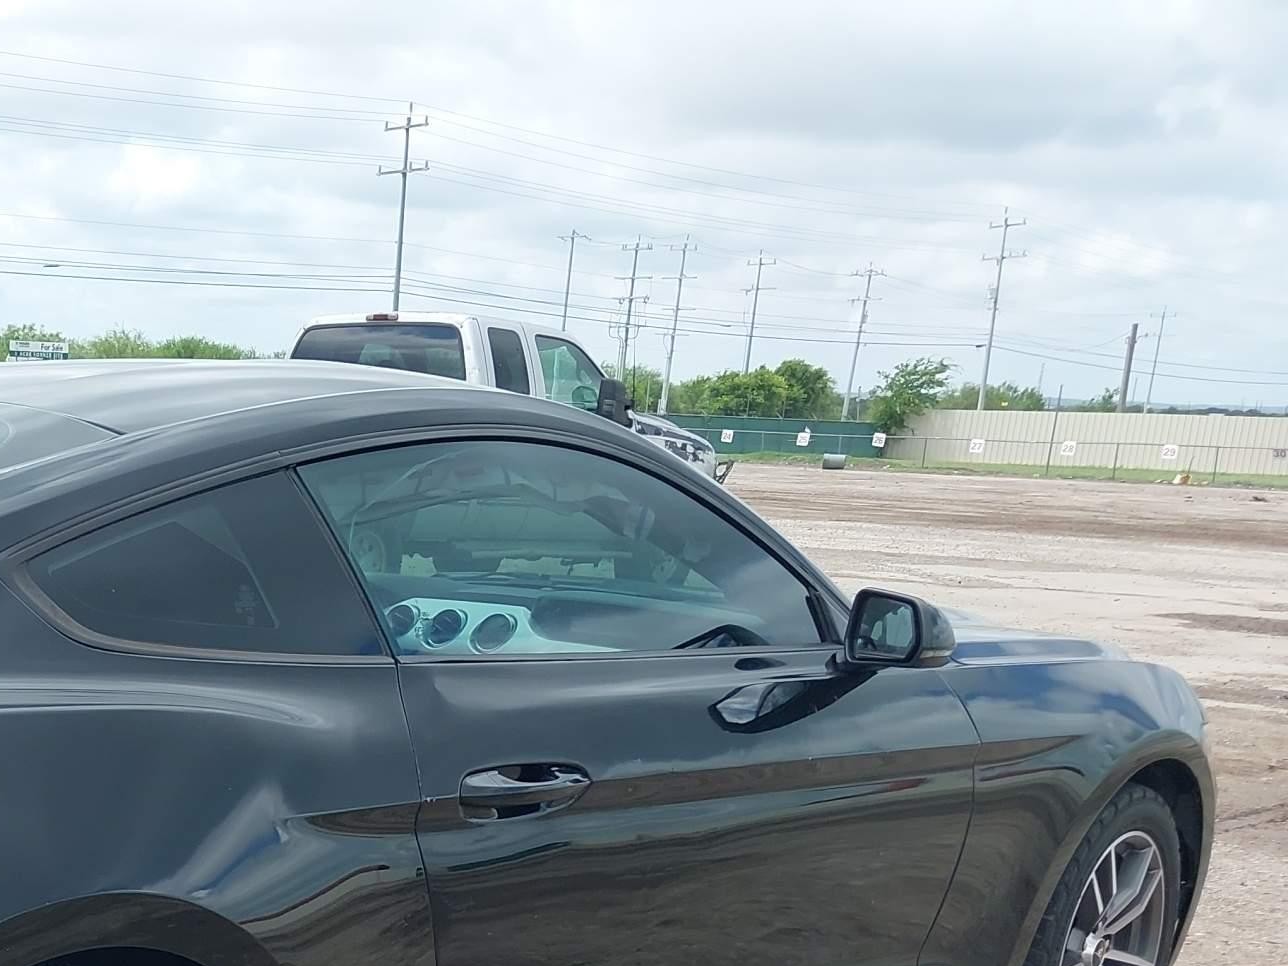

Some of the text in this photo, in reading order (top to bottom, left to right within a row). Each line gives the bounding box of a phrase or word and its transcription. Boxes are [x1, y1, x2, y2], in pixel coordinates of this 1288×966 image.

[40, 343, 64, 351] For Sale
[722, 432, 732, 441] 24
[970, 441, 983, 451] 27
[1062, 444, 1075, 453] 28
[1162, 447, 1176, 457] 29
[1273, 448, 1286, 458] 30
